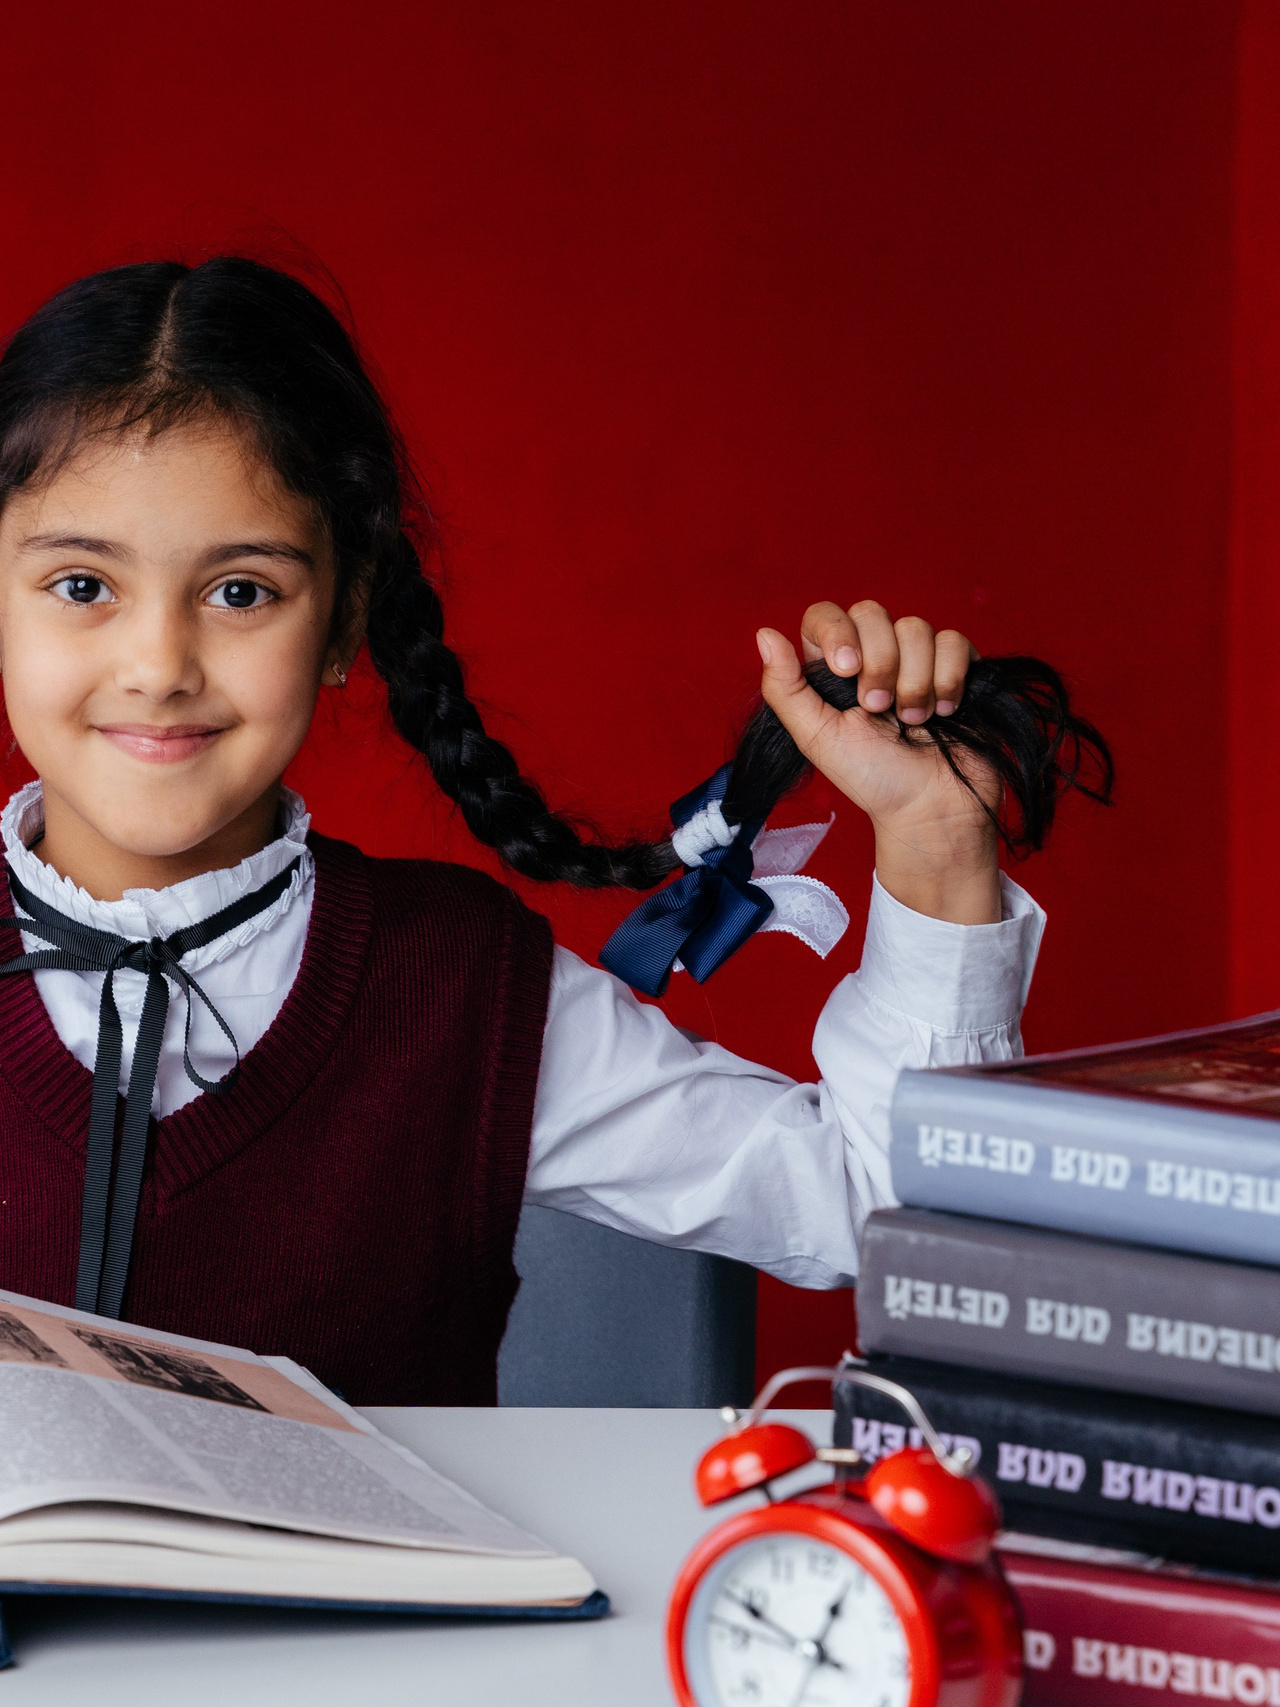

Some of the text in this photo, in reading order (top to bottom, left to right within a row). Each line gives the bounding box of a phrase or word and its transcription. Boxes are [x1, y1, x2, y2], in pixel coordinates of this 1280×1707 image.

[917, 1124, 1035, 1176] ДЕТЕЙ
[1050, 1145, 1131, 1191] ДЛЯ
[884, 1275, 1280, 1373] ПЕДИЯ ДЛЯ ДЕТЕЙ
[996, 1442, 1086, 1493] ДЛЯ
